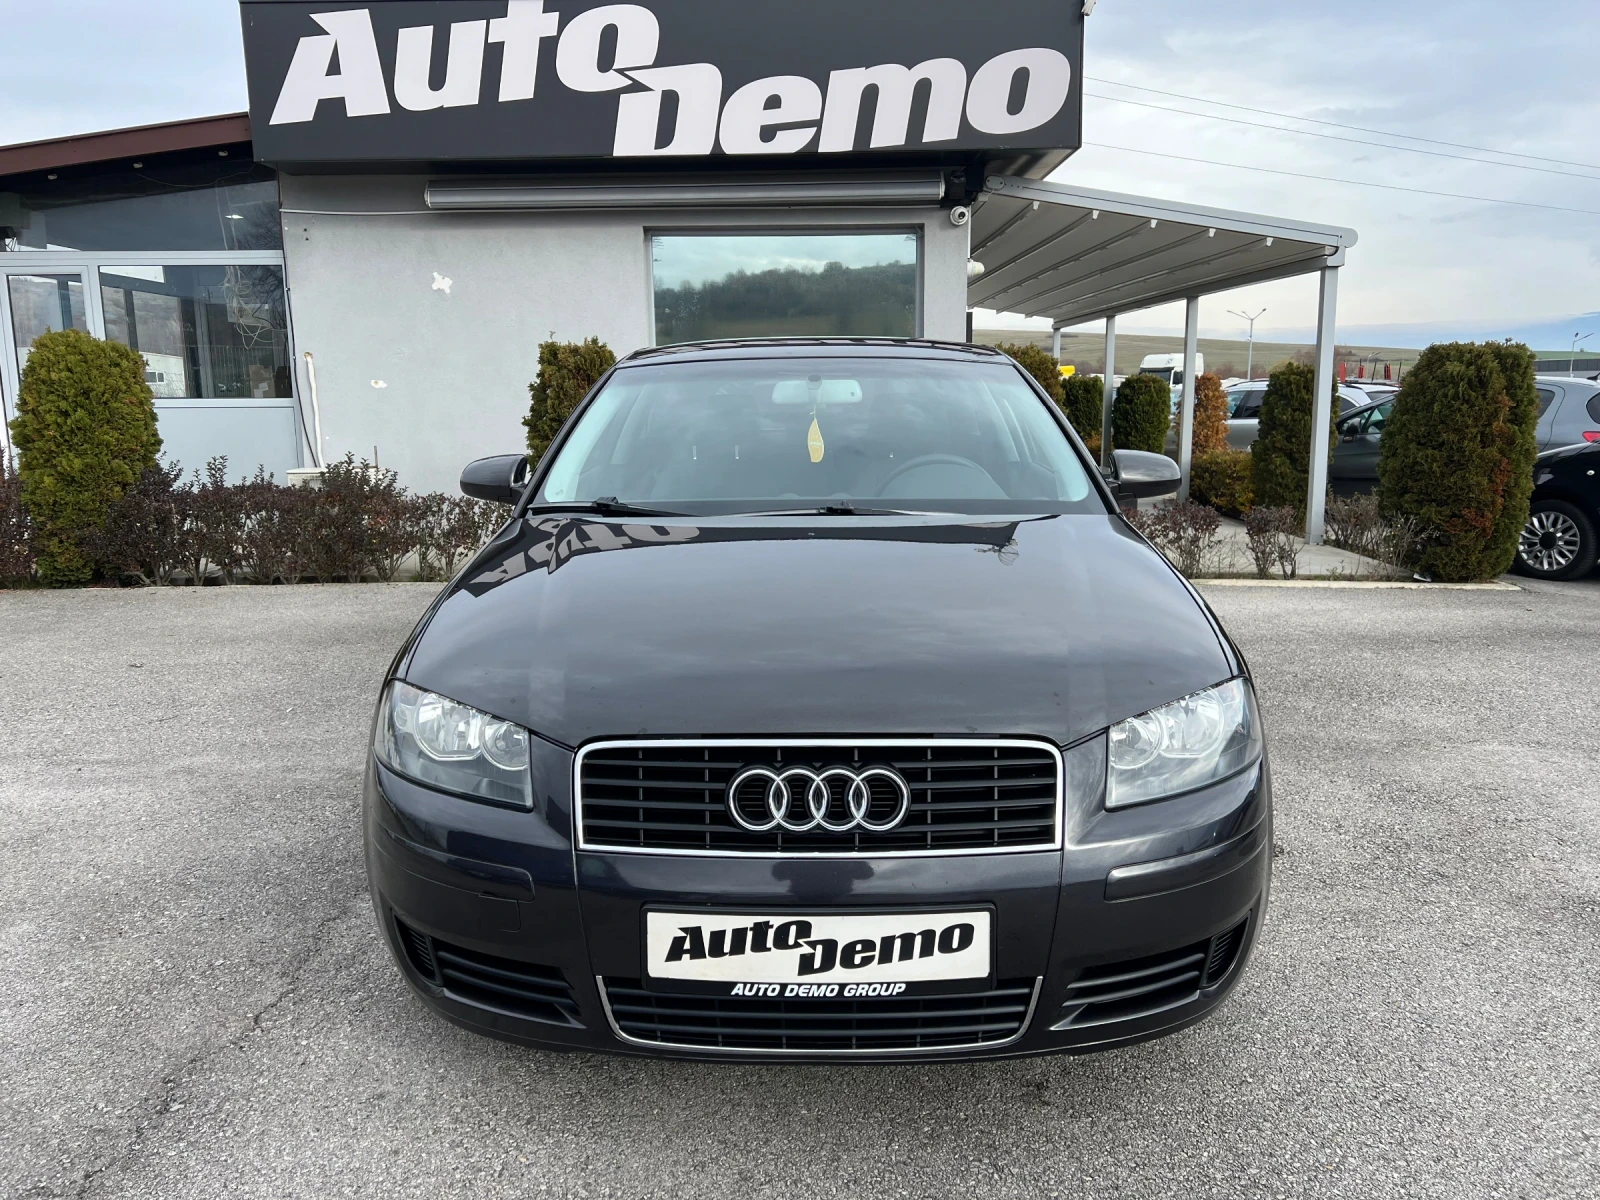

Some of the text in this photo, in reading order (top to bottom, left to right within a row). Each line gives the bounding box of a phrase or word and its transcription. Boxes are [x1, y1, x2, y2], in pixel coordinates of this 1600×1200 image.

[269, 0, 1071, 157] Auto Demo
[664, 919, 975, 977] Auto Demo
[730, 982, 907, 997] AUTO DEMO GROUP
